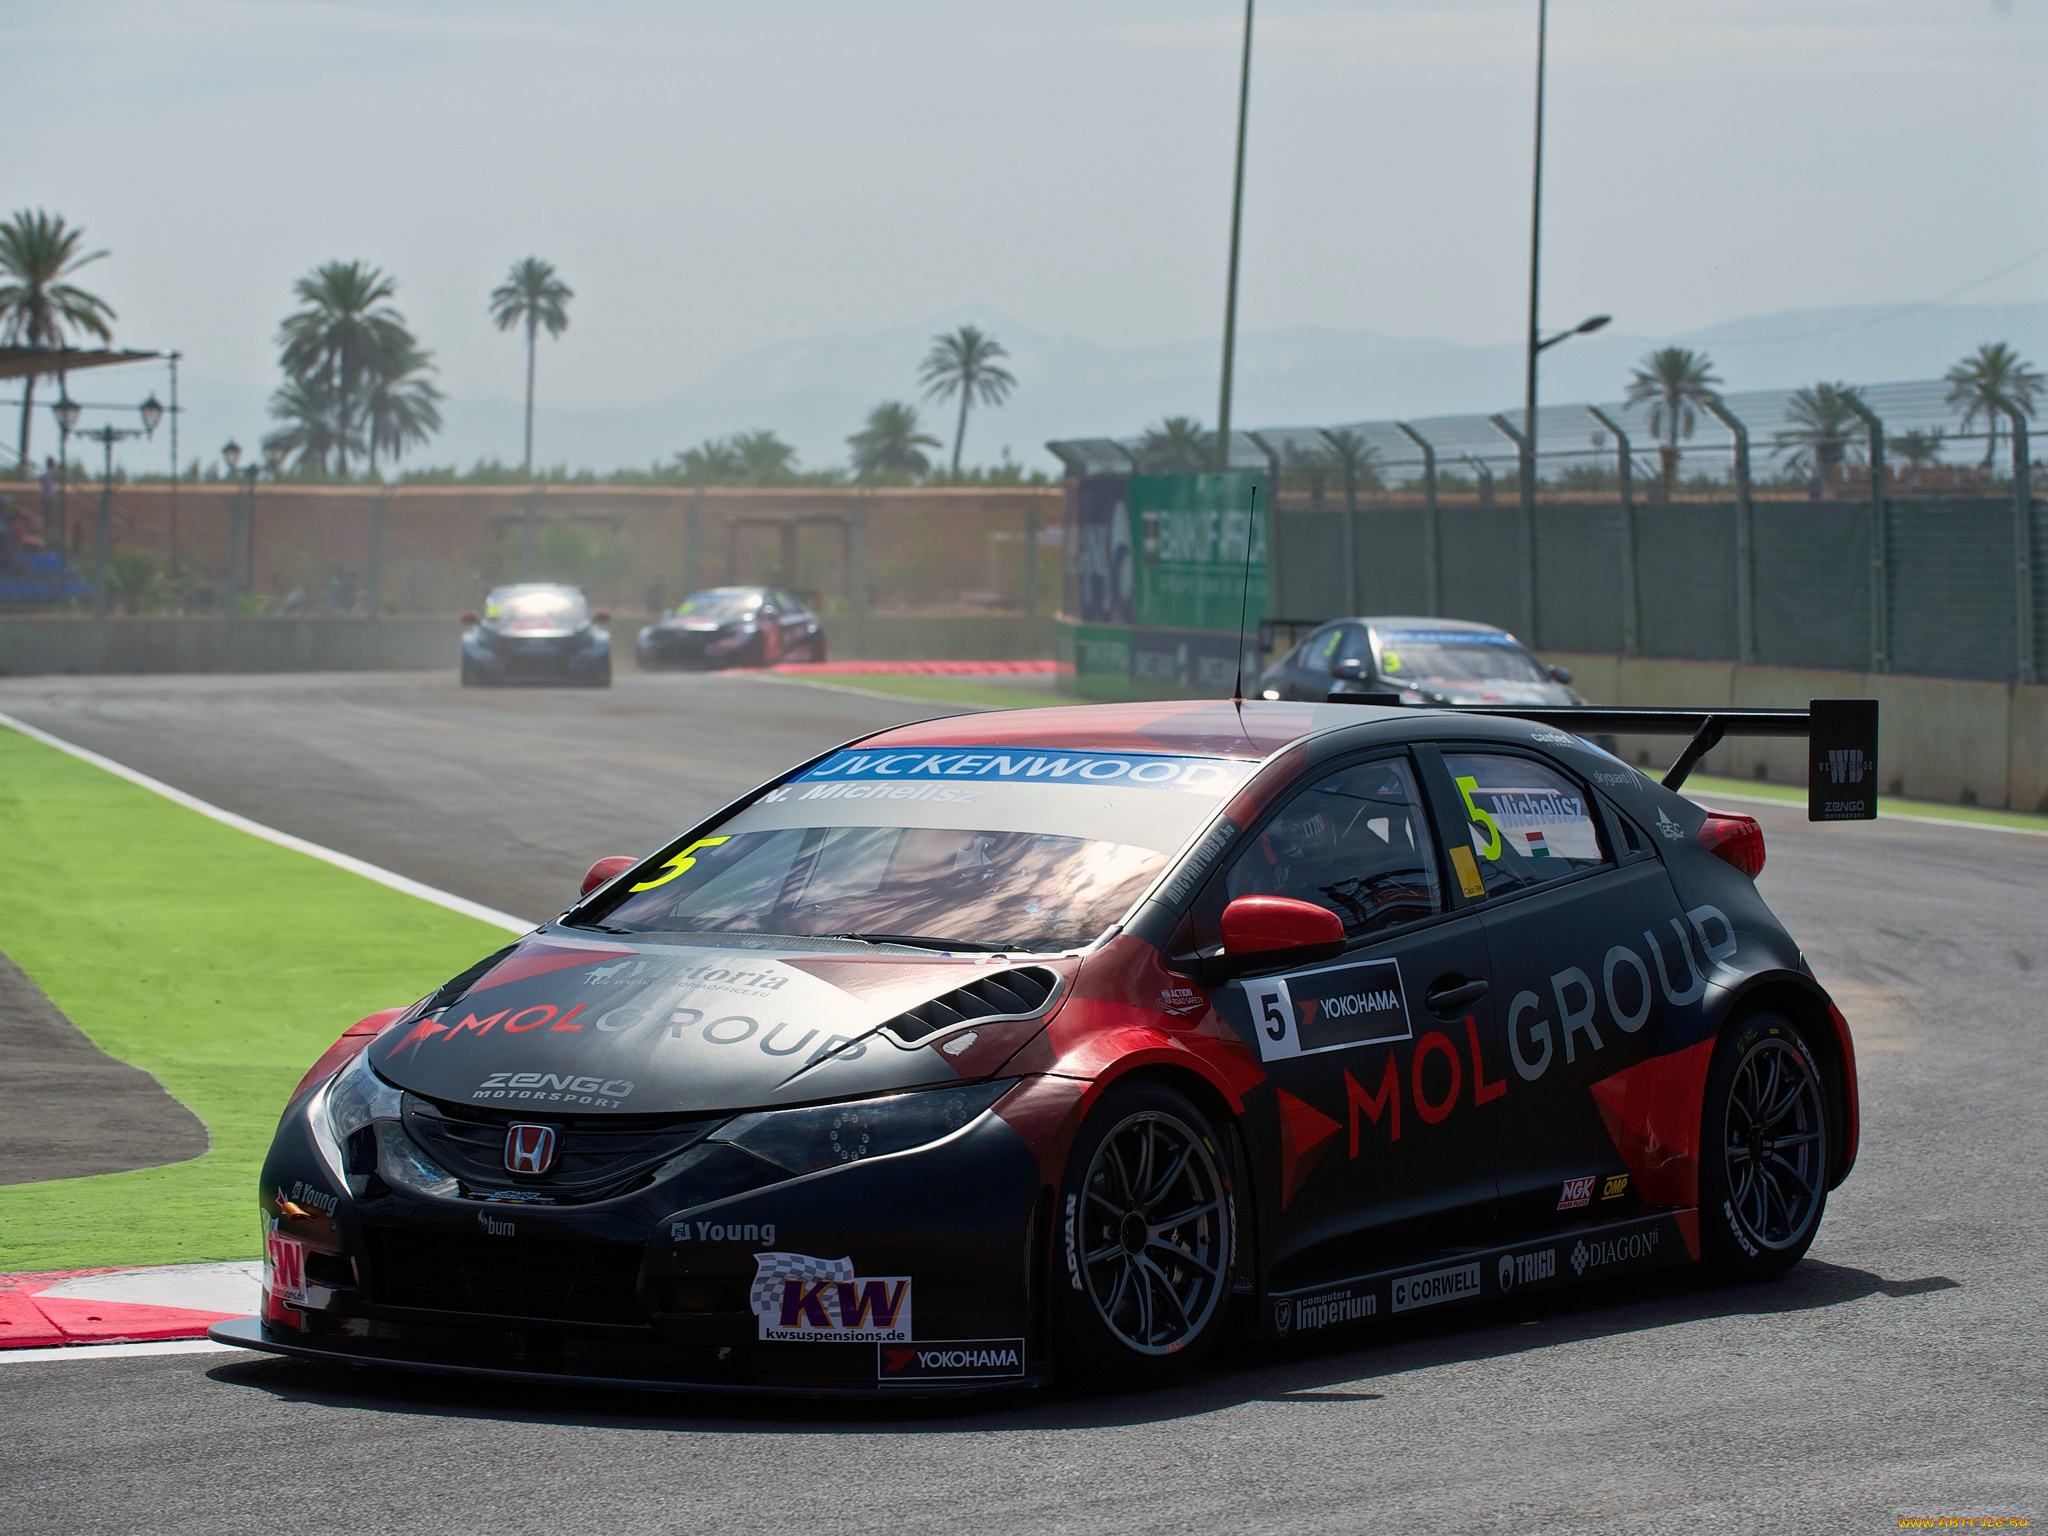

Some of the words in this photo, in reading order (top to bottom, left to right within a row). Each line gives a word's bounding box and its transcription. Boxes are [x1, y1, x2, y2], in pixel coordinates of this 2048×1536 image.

[797, 782, 986, 805] Michelisz
[1455, 776, 1502, 861] 5
[1491, 794, 1588, 828] Michelisz
[628, 835, 732, 892] 5
[629, 960, 789, 990] Victoria
[1261, 993, 1286, 1041] 5
[1320, 990, 1400, 1019] YOKOHAMA
[472, 1089, 623, 1109] MOTORSPORT
[302, 1183, 338, 1217] Young
[1561, 1179, 1594, 1202] NGK
[1604, 1178, 1628, 1197] OMP
[488, 1216, 515, 1236] burn
[696, 1221, 776, 1246] Young
[1515, 1248, 1556, 1284] TRIGO
[1411, 1271, 1479, 1302] CORWELL
[779, 1279, 910, 1329] KW
[1297, 1291, 1377, 1330] Imperium
[766, 1328, 905, 1342] kwsuspensions.de
[917, 1349, 1019, 1369] YOKOHAMA
